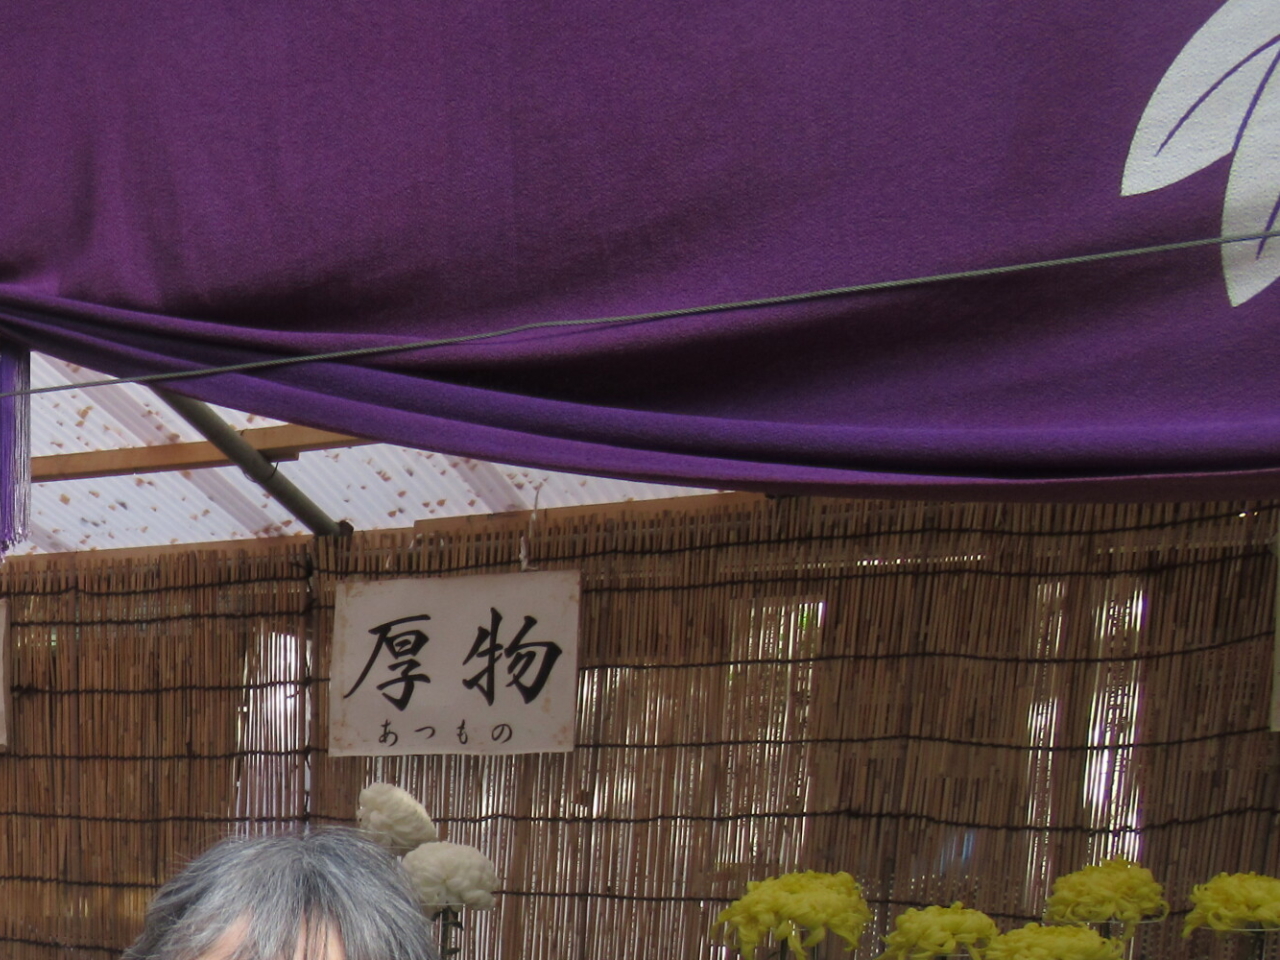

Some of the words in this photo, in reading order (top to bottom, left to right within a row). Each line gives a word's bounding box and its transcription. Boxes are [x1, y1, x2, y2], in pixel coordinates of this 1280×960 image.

[343, 607, 563, 711] 厚物
[378, 719, 513, 747] あつもの
